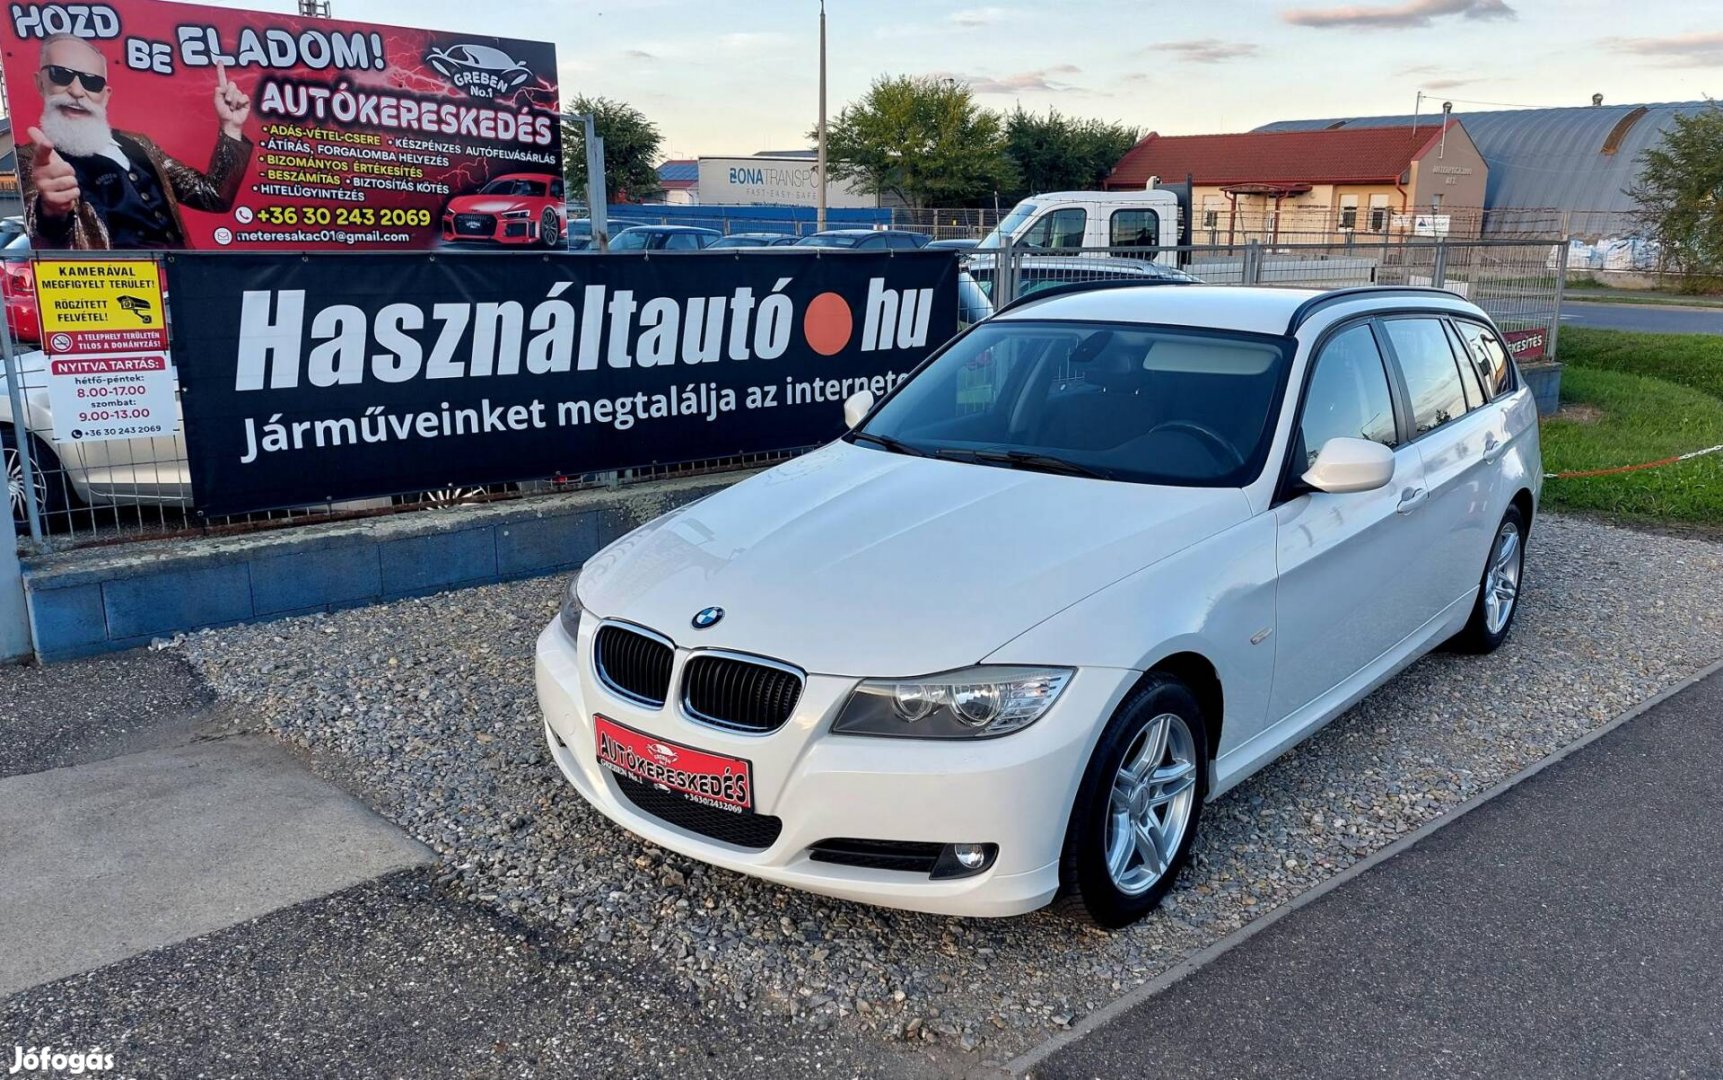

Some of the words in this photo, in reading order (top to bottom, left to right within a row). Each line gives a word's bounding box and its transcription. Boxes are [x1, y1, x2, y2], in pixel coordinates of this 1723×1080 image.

[12, 5, 119, 38] HOZD
[127, 38, 172, 74] BE
[177, 26, 385, 69] ELADOM!
[453, 71, 508, 93] GREBEN
[470, 85, 493, 98] No.1
[261, 82, 551, 145] AUTÓKERESKEDÉS
[270, 125, 381, 145] ADÁS-VÉTEL-CSERE
[267, 137, 315, 154] ÁTÍRÁS,
[317, 144, 397, 161] FORGALOMBA
[399, 153, 449, 167] HELYEZÉS
[395, 137, 461, 154] KÉSZPÉNZES
[466, 146, 556, 164] AUTÓFELVÁSÁRLÁS
[267, 154, 349, 171] BIZOMÁNYOS
[353, 160, 423, 178] ÉRTÉKESÍTÉS
[268, 169, 341, 185] BESZÁMÍTÁS
[353, 177, 415, 191] BIZTOSÍTÁS
[416, 181, 449, 194] KÖTÉS
[261, 183, 365, 201] HITELÜGYINTÉZÉS
[257, 207, 298, 224] +36
[302, 207, 331, 224] 30
[336, 208, 375, 225] 243
[380, 209, 431, 226] 2069
[59, 265, 136, 277] KAMERÁVAL
[42, 280, 105, 289] MEGFIGYELT
[110, 277, 155, 289] TERÜLET!
[55, 298, 108, 310] RÖGZÍTETT
[57, 311, 109, 322] FELVÉTEL!
[84, 333, 121, 341] TELEPHELY
[123, 331, 160, 340] TERÜLETÉN
[58, 361, 108, 373] NYITVA
[109, 358, 160, 370] TARTÁS:
[77, 385, 146, 398] 8.00-17.00
[91, 399, 137, 408] szombat:
[79, 408, 150, 421] 9.00-13.00
[240, 398, 546, 464] Járműveinket
[557, 382, 736, 430] megtalálja
[746, 383, 778, 409] az
[84, 429, 101, 437] +36
[138, 425, 161, 433] 2069
[600, 731, 747, 804] AUTÓKERESKEDÉS
